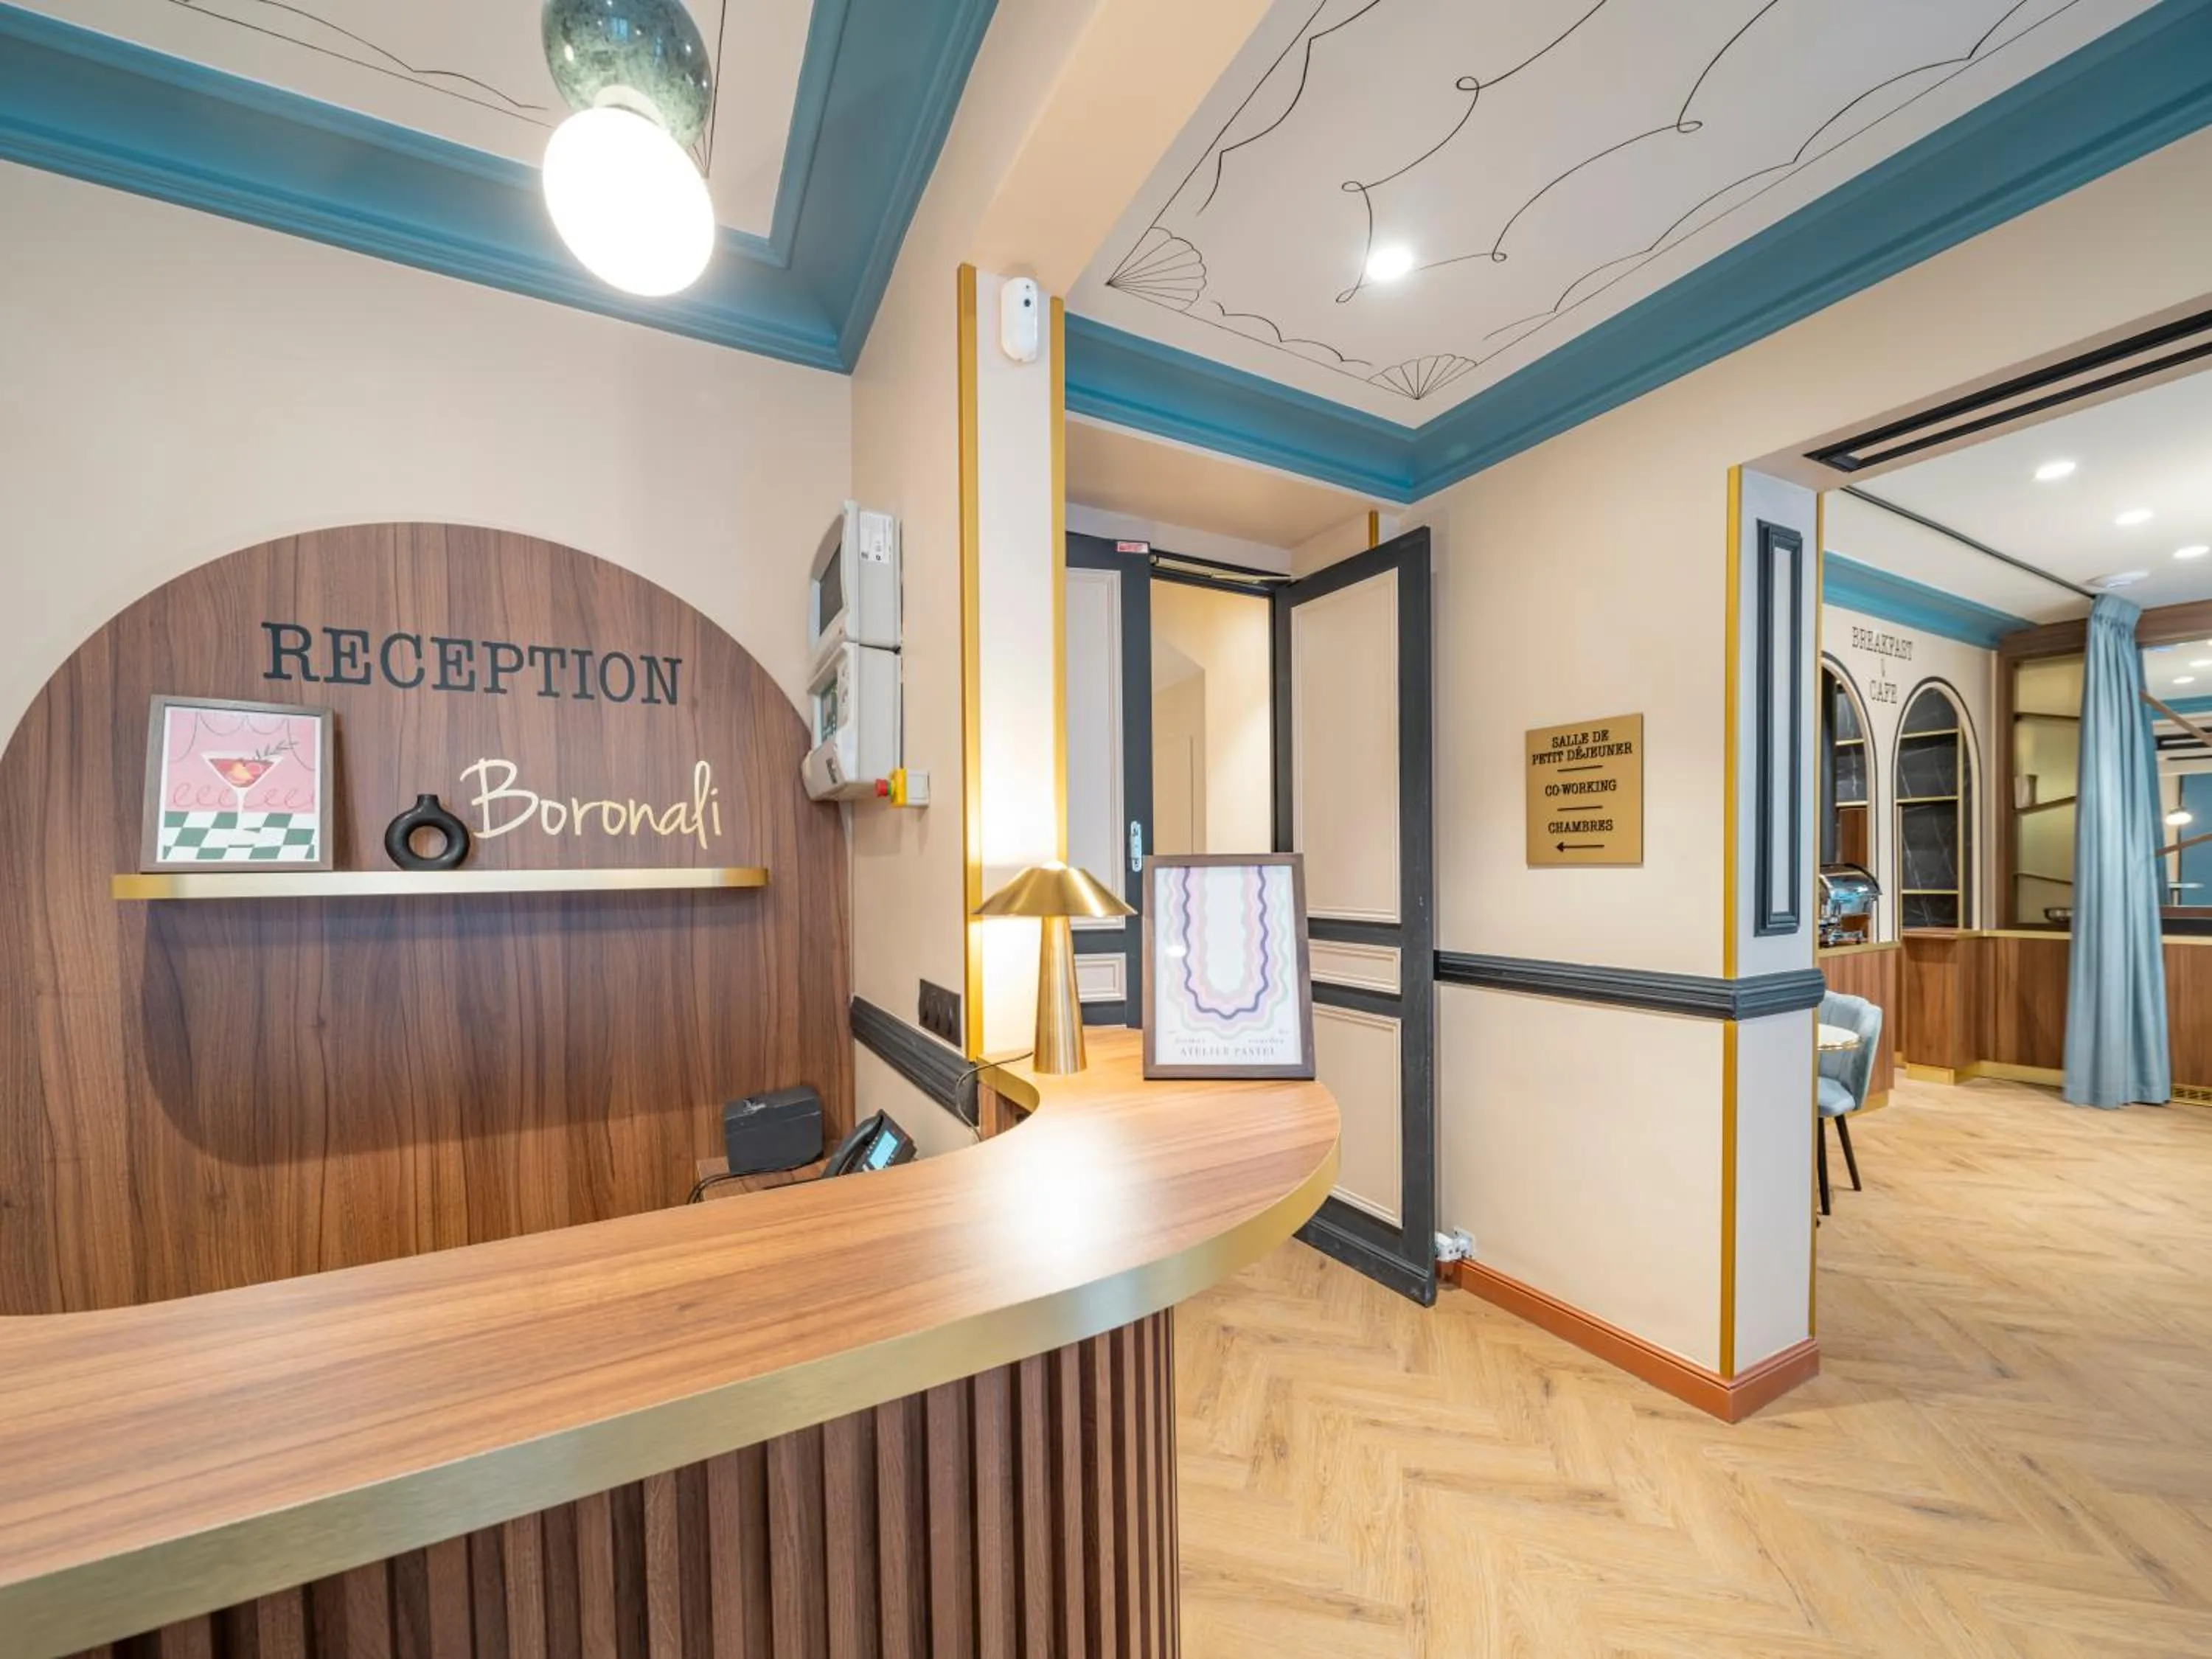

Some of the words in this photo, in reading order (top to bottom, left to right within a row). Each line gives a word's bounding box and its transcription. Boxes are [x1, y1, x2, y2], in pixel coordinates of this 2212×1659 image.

[1852, 627, 1913, 661] BREAKFAST
[261, 622, 682, 705] RECEPTION
[1552, 734, 1588, 748] SALLE
[1593, 729, 1609, 742] DE
[1531, 751, 1564, 765] PETIT
[1567, 742, 1632, 762] DÉJEUNER
[460, 758, 722, 849] Boronali
[1548, 819, 1613, 834] CHAMBRES
[1180, 1046, 1229, 1056] ATELIER
[1234, 1046, 1275, 1056] PASTEL
